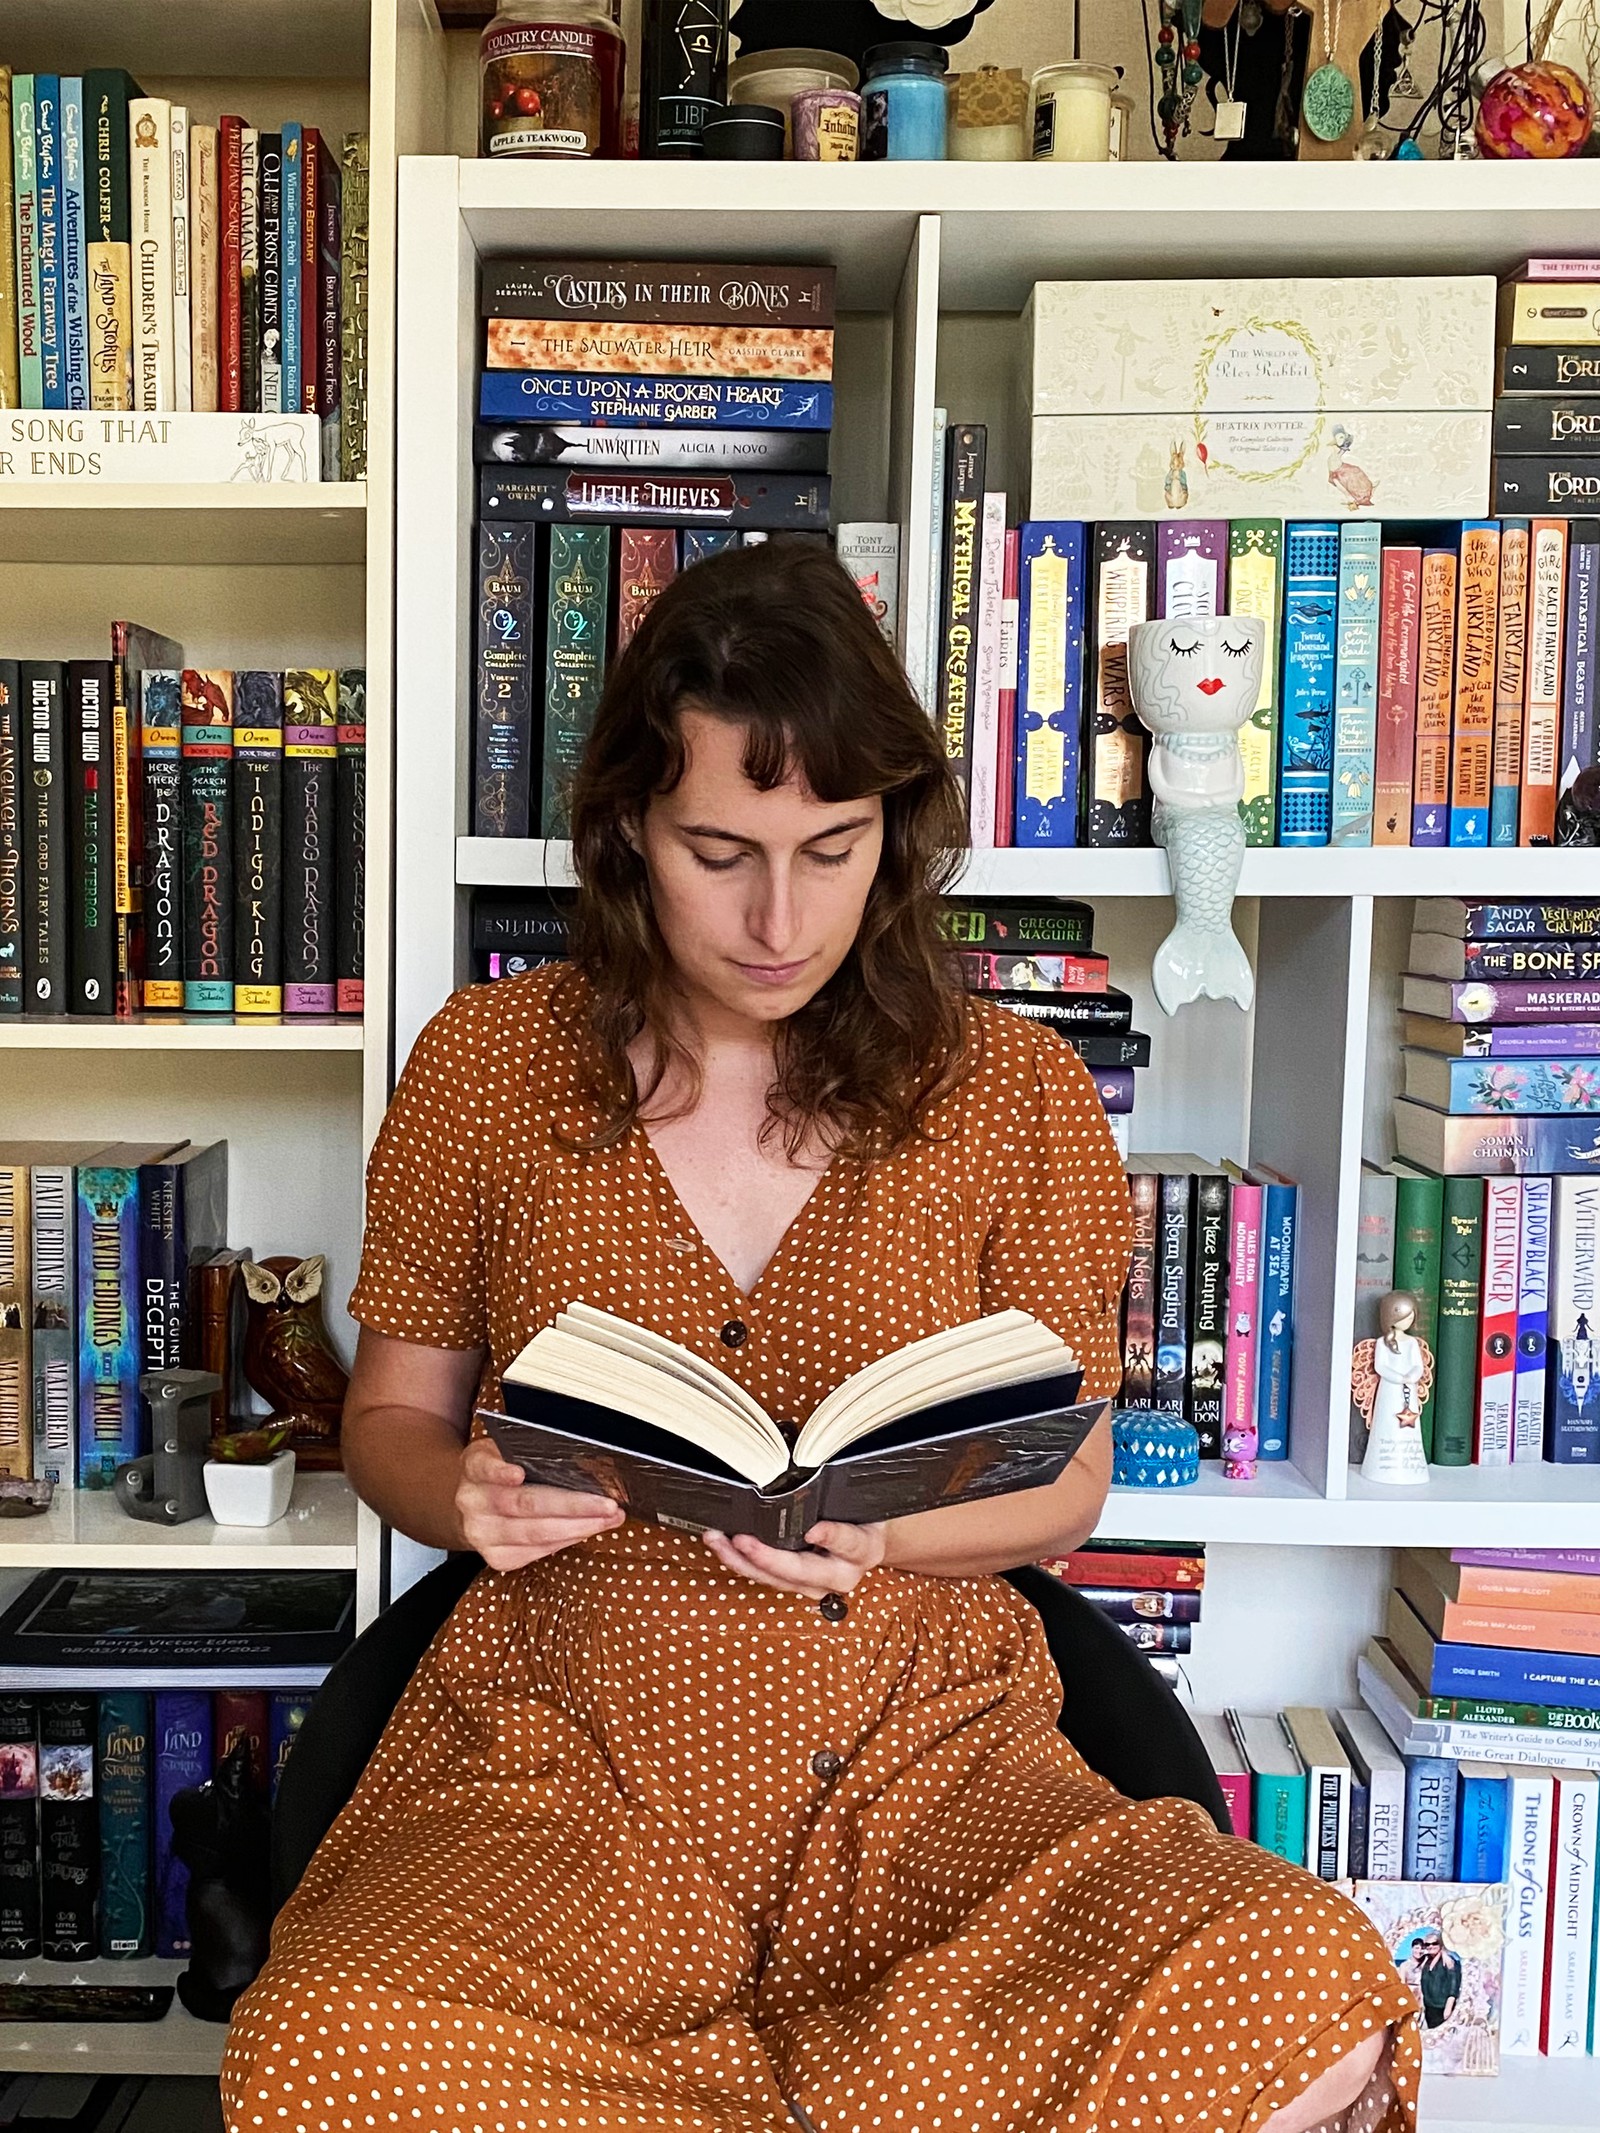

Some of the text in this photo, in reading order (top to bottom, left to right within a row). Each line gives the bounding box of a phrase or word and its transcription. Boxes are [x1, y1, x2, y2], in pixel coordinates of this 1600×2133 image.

[488, 30, 539, 50] COUNTRY
[541, 30, 593, 46] CANDLE
[493, 136, 516, 147] APPLE
[526, 134, 581, 144] TEAKWOOD
[98, 117, 111, 223] CHRIS COLFER
[240, 141, 254, 260] NEIL GAIMAN
[20, 190, 37, 357] The Enchanted Wood
[264, 218, 279, 324] FROST GIANTS
[305, 142, 316, 400] A LITERARY BESTIARY BY
[39, 185, 59, 389] The Magic Faraway Tree
[66, 187, 84, 382] Adventures of the Wishing
[140, 239, 158, 335] CHILDREN'S
[544, 274, 790, 313] CASTLES IN THEIR BONES
[542, 338, 806, 360] THE HEIR CASSIDY CLARKE
[1229, 349, 1249, 358] THE
[1252, 349, 1285, 357] WORLD
[1512, 364, 1527, 375] 2
[521, 377, 784, 409] ONCE UPON A BROKEN HEART
[591, 400, 717, 421] STEPHANIE GARBER
[11, 419, 172, 443] SONG THAT
[1216, 421, 1305, 430] BEATRIX POTTER
[587, 433, 768, 461] UNWRITTEN ALICIA NOVO
[31, 452, 101, 475] ENDS
[497, 484, 549, 493] MARGARET
[507, 492, 537, 501] OWEN
[581, 481, 721, 508] LITTLE THIEVES
[1504, 482, 1519, 493] 3
[842, 545, 896, 554] DITERLIZZI
[856, 535, 883, 544] TONY
[492, 582, 521, 593] BAUM
[563, 582, 593, 593] BAUM
[944, 500, 977, 759] MYTHICAL CREATURES
[1462, 583, 1484, 678] FAIRYLAND
[1574, 574, 1590, 705] FANTASTICAL BEASTS
[1423, 601, 1444, 687] FAIRYLAND
[1500, 601, 1524, 694] FAIRYLAND
[1543, 586, 1558, 697] RACED FAIRYLAND
[497, 683, 511, 698] 2
[567, 683, 581, 698] 3
[1103, 655, 1124, 706] WARS
[82, 679, 99, 761] DOCTOR WHO
[196, 729, 222, 740] Owen
[32, 680, 50, 963] DOCTOR WHO TIME LORD FAIRY TALES
[1019, 917, 1085, 930] GREGORY
[1490, 908, 1533, 920] ANDY
[1018, 929, 1083, 941] MAGUIRE
[1486, 921, 1536, 933] SAGAR
[1546, 920, 1593, 934] CRUMB
[1483, 952, 1575, 970] THE BONE
[1480, 1135, 1523, 1146] SOMAN
[1473, 1148, 1535, 1158] CHAINANI
[36, 1175, 64, 1291] DAVID EDDINGS
[1520, 1182, 1550, 1300] SHADOWBLACK
[1129, 1214, 1153, 1299] Wolf Notes
[1268, 1236, 1280, 1277] AT SEA
[1278, 1216, 1292, 1297] MOOMINPAPPA
[1487, 1185, 1518, 1305] SPELLSLINGER
[1572, 1187, 1599, 1311] WITHERWARD
[1162, 1213, 1187, 1328] Storm Singing
[1199, 1216, 1221, 1331] Maze Running
[92, 1222, 122, 1442] DAVID EDDINGS TAMULI
[1235, 1351, 1247, 1422] TOVE JANSSON
[46, 1361, 68, 1449] MALLOREON
[1194, 1400, 1220, 1412] LARI
[1194, 1412, 1220, 1422] DON
[1477, 1585, 1551, 1596] LOUISA MAY ALCOTT
[61, 1645, 271, 1655] 08/03/1940 09/01/2022
[95, 1638, 249, 1648] Barry Victor Eden
[1452, 1668, 1500, 1677] DODIE SMITH
[1529, 1673, 1567, 1684] CAPTURE
[1569, 1676, 1586, 1686] THE
[1462, 1713, 1515, 1724] ALEXANDER
[1475, 1705, 1504, 1714] LLOYD
[103, 1734, 146, 1762] LAND
[1460, 1729, 1582, 1747] The Writer's Guide to Good
[1452, 1745, 1567, 1766] Write Great Dialogue
[102, 1763, 146, 1783] STORIES
[1321, 1776, 1338, 1848] THE PRINCESS
[1513, 1792, 1543, 1938] THRONE of GLASS
[1564, 1792, 1588, 1939] CROWN of MIDNIGHT
